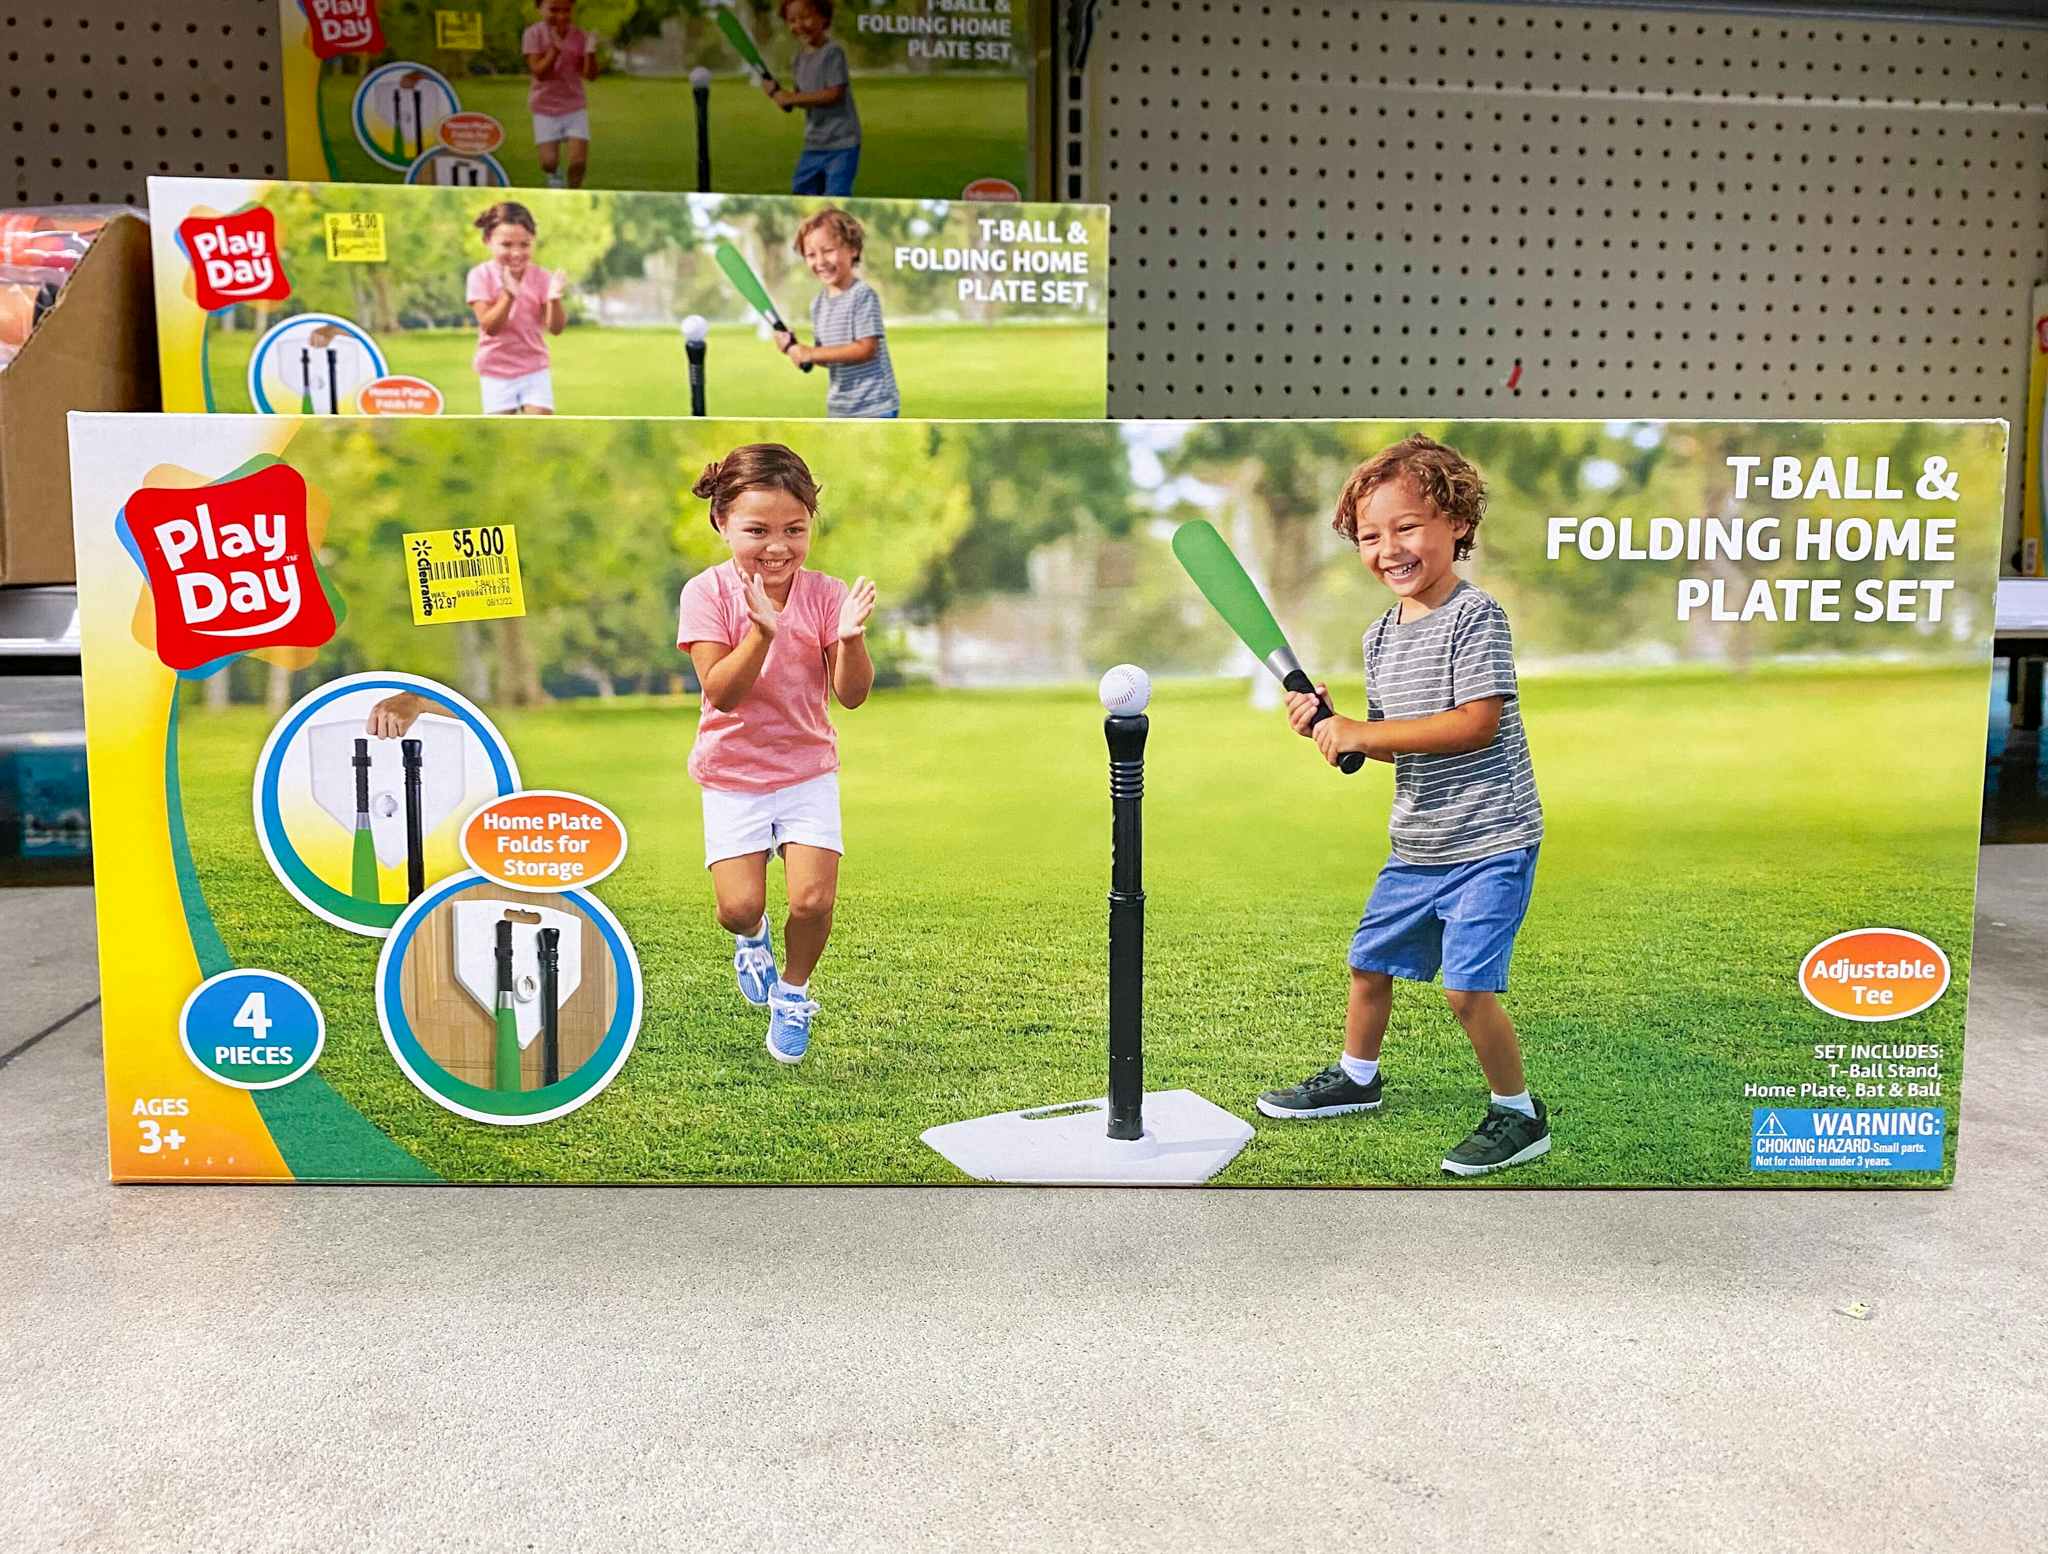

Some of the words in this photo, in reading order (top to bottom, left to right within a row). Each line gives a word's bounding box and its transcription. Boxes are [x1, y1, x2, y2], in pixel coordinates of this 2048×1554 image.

[321, 17, 372, 48] Day
[857, 14, 947, 34] FOLDING
[951, 16, 1011, 36] HOME
[908, 40, 971, 58] PLATE
[974, 41, 1011, 60] SET
[193, 225, 265, 260] Play
[978, 219, 1062, 243] T-BALL
[1067, 221, 1089, 244] &
[894, 247, 1007, 272] FOLDING
[1012, 251, 1089, 274] HOME
[205, 257, 274, 296] Day
[958, 279, 1037, 302] PLATE
[1041, 281, 1089, 304] SET
[1727, 456, 1903, 500] T-BALL
[1915, 455, 1960, 501] &
[153, 503, 286, 572] Play
[453, 526, 504, 558] $5.00
[1547, 516, 1781, 561] FOLDING
[1795, 517, 1957, 561] HOME
[417, 558, 434, 617] Clearance
[176, 564, 301, 637] Day
[434, 596, 457, 609] 12.97
[1677, 579, 1841, 622] PLATE
[1853, 579, 1954, 623] SET
[483, 812, 544, 830] Home
[547, 812, 603, 830] Plate
[497, 836, 553, 853] Folds
[557, 835, 590, 853] for
[503, 859, 584, 881] Storage
[1812, 959, 1936, 984] Adjustable
[1851, 986, 1894, 1005] Tee
[233, 992, 272, 1039] 4
[215, 1046, 294, 1065] PIECES
[1814, 1044, 1847, 1059] SET
[1851, 1044, 1944, 1060] INCLUDES:
[1828, 1063, 1884, 1079] T-Ball
[1887, 1063, 1943, 1080] Stand,
[1744, 1083, 1796, 1097] Home
[1800, 1082, 1851, 1100] Plate,
[1855, 1083, 1885, 1097] Bat
[1888, 1083, 1904, 1097] &
[1907, 1083, 1941, 1097] Ball
[132, 1098, 190, 1116] AGES
[138, 1119, 187, 1154] 3+
[1813, 1112, 1941, 1136] WARNING:
[1756, 1138, 1815, 1154] CHOKING
[1900, 1143, 1927, 1156] parts.
[1756, 1156, 1772, 1166] Not
[1774, 1156, 1788, 1166] for
[1789, 1156, 1827, 1167] children
[1829, 1156, 1856, 1167] under
[1857, 1156, 1863, 1167] 3
[1864, 1157, 1893, 1169] years.
